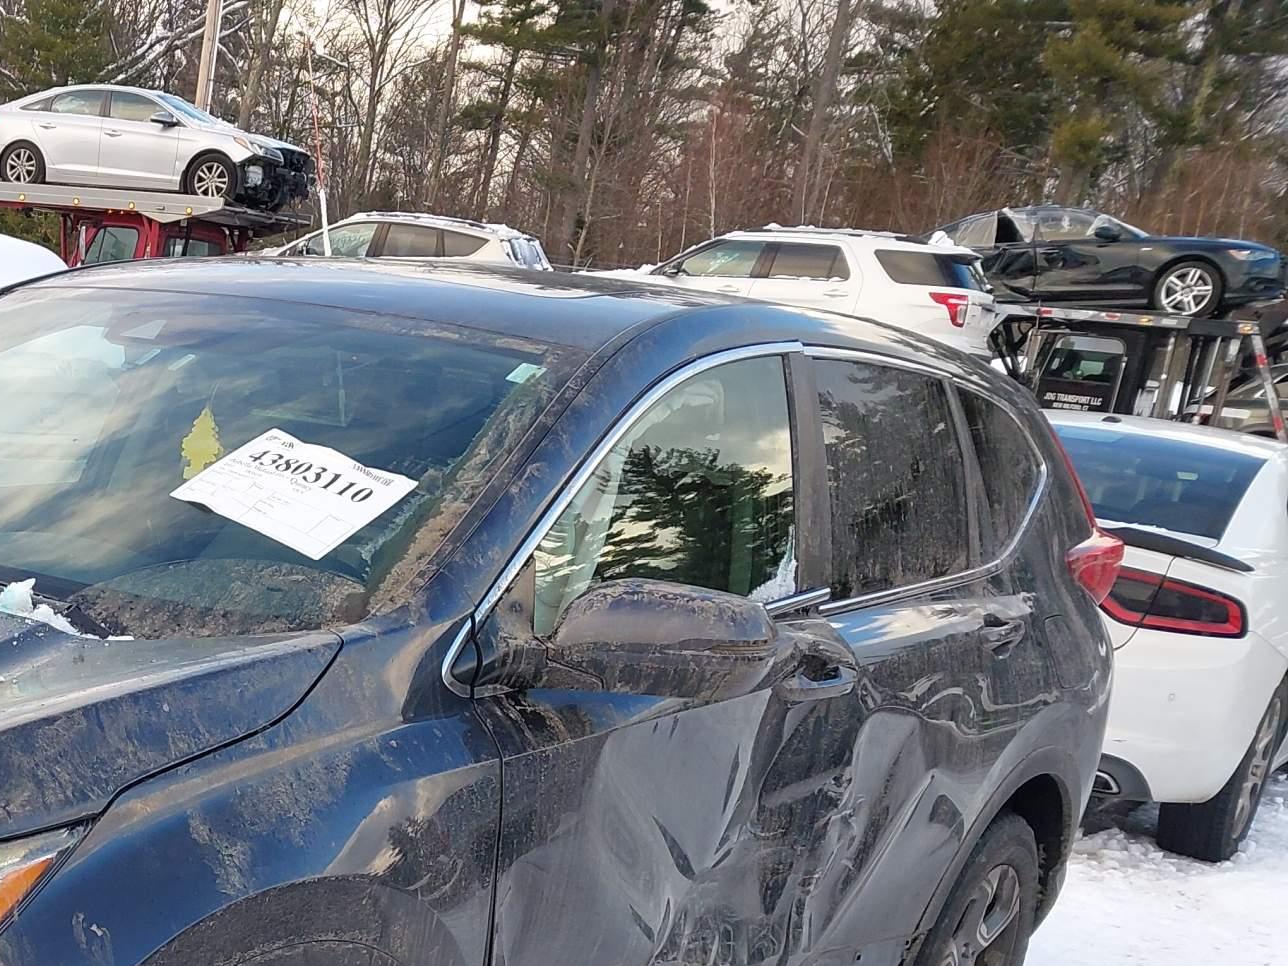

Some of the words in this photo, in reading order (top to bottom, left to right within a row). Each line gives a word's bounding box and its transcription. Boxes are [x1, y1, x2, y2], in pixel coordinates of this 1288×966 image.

[1057, 393, 1091, 404] TRANSPORT
[1090, 397, 1102, 405] LLC
[248, 450, 374, 503] 43803110
